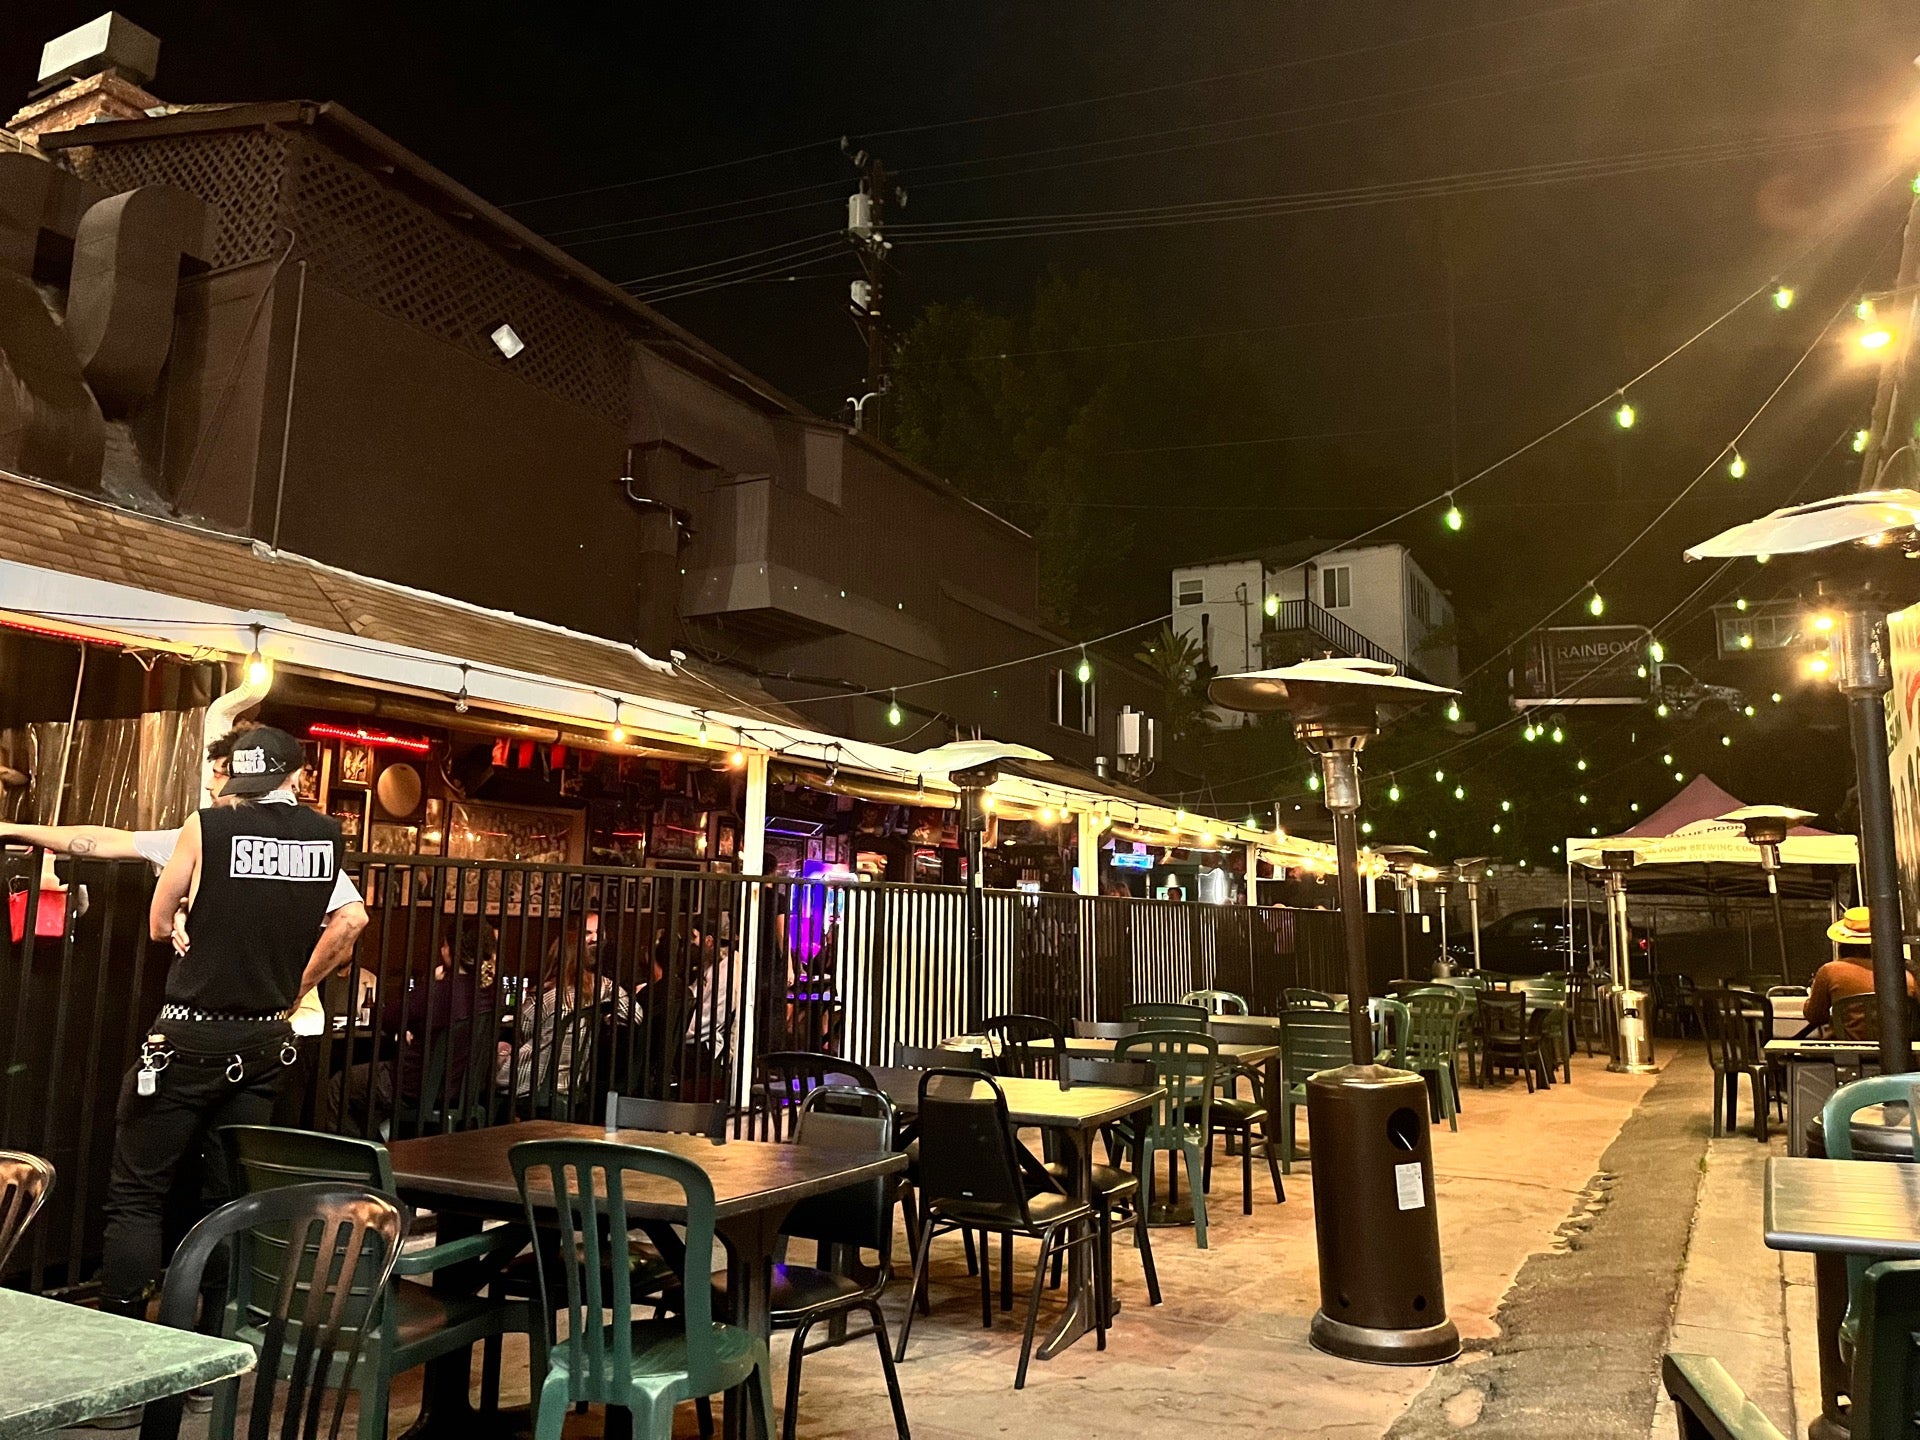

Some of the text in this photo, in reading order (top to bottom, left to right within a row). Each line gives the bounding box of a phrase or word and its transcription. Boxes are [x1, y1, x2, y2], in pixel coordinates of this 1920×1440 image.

[1557, 641, 1640, 659] RAINBOW
[1706, 825, 1743, 833] MOON
[1689, 843, 1733, 852] BREWING
[235, 840, 332, 877] SECURITY
